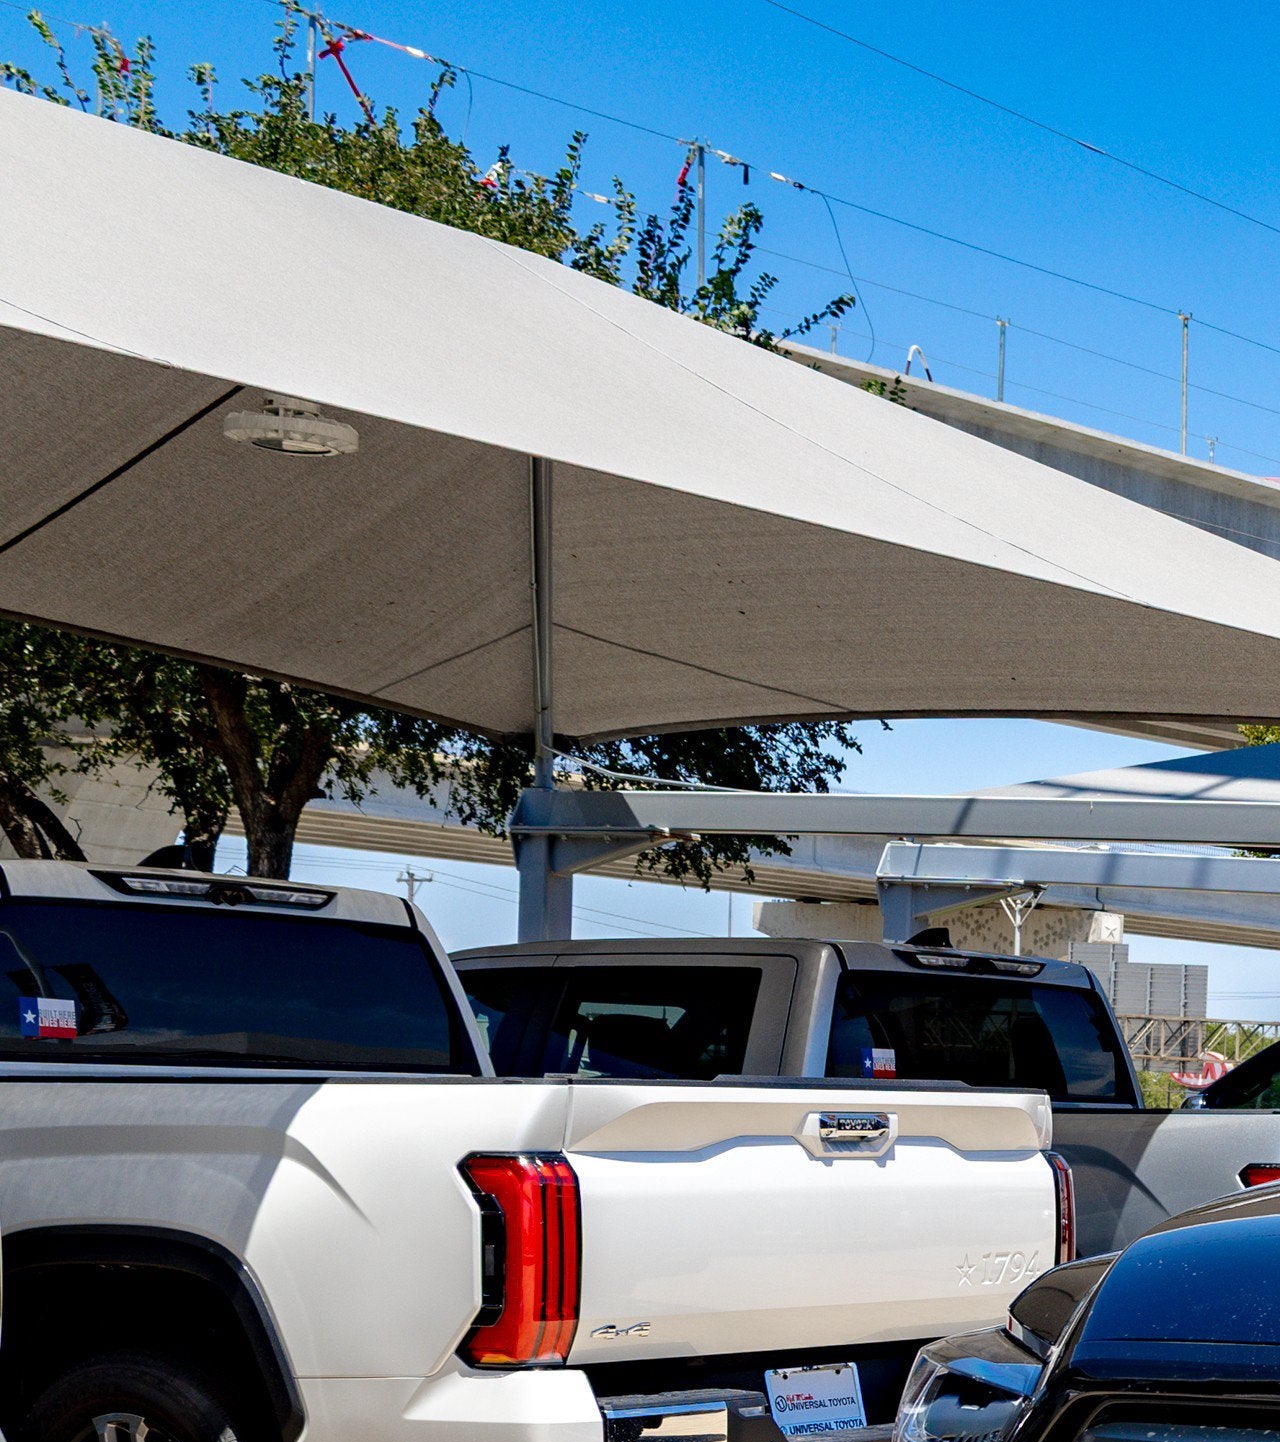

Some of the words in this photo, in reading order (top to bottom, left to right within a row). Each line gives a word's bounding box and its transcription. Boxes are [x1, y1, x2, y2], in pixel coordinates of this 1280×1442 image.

[981, 1249, 1041, 1285] 1794
[787, 1400, 828, 1411] UNIVERSAL
[828, 1396, 857, 1408] TOYOTA
[789, 1423, 834, 1435] UNIVERSAL
[833, 1418, 865, 1430] TOYOTA
